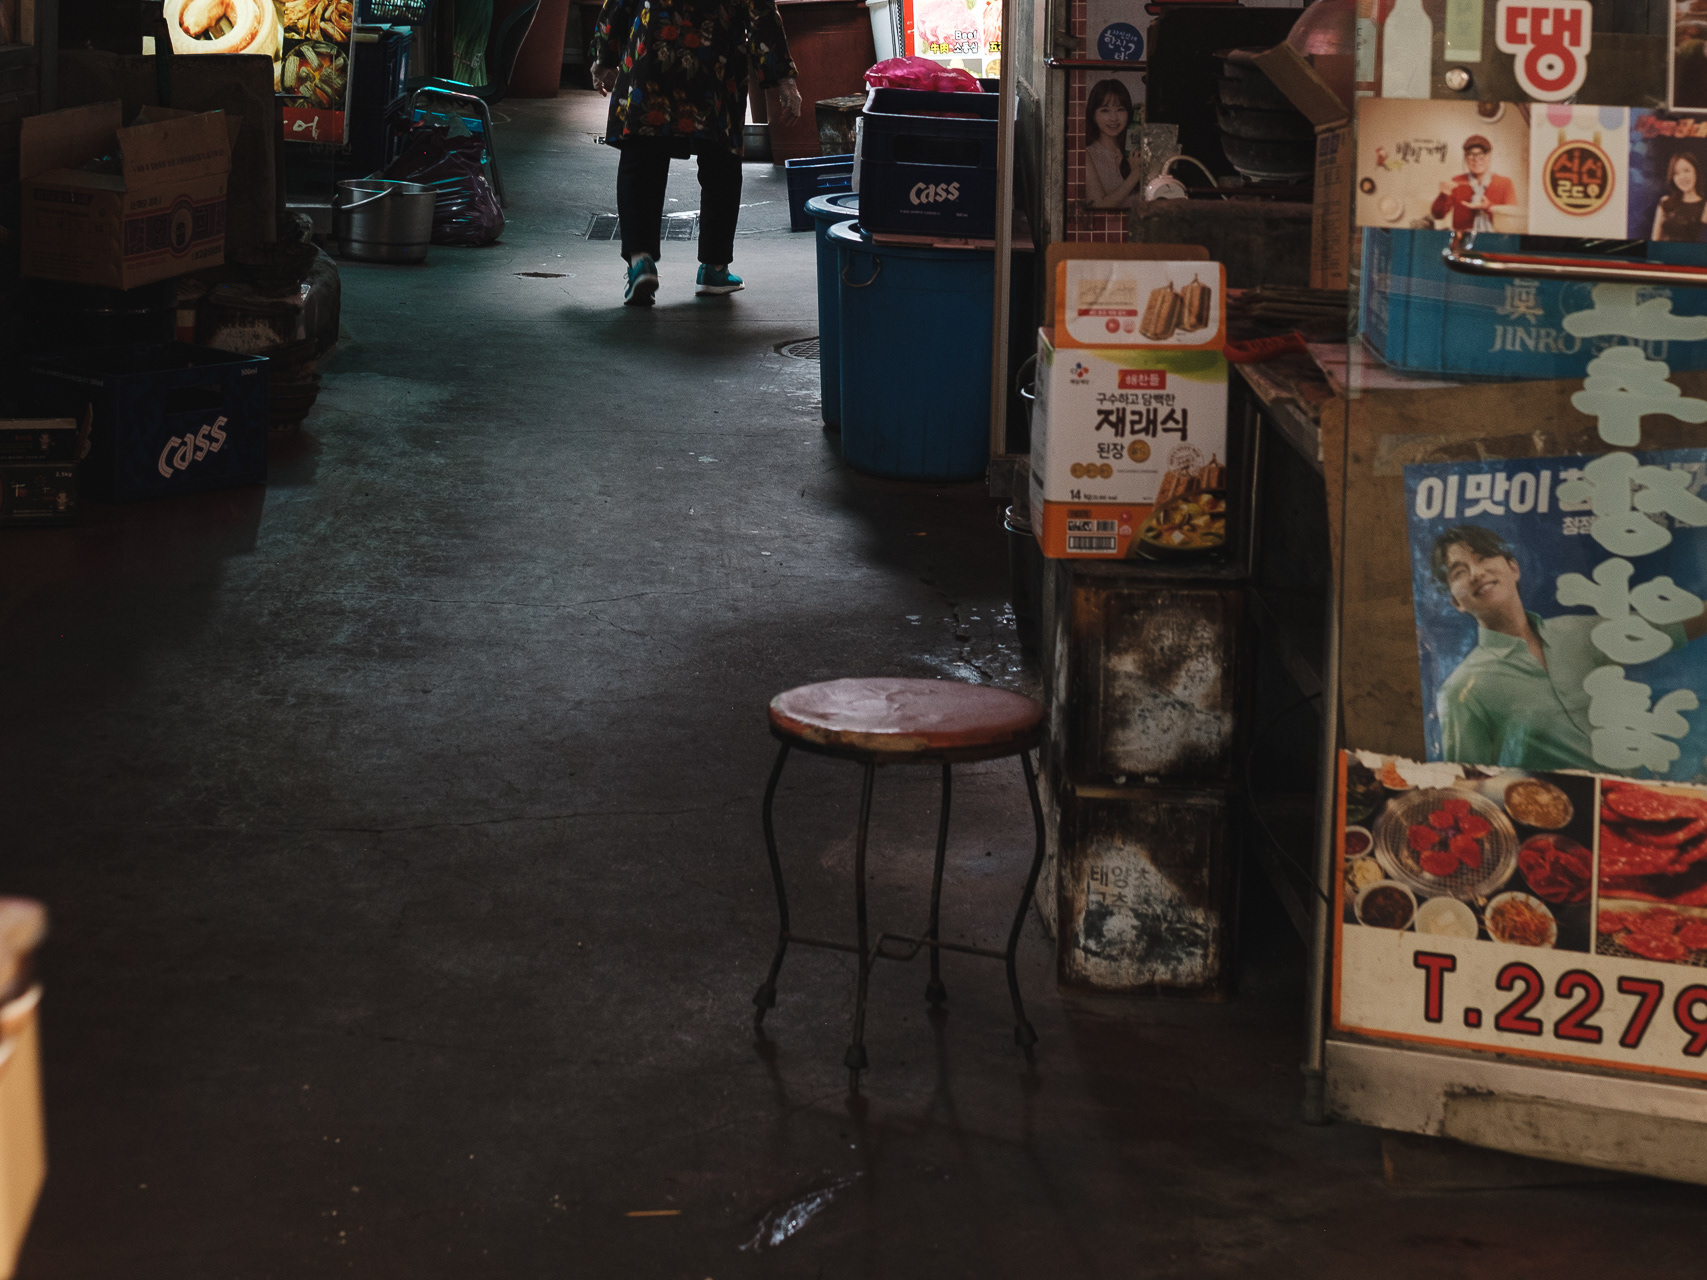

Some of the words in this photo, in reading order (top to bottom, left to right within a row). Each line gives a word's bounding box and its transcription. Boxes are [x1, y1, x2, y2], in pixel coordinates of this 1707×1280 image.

[954, 30, 978, 41] Beef
[1488, 324, 1583, 355] JINRO
[1096, 393, 1139, 406] 구수하고
[1095, 407, 1188, 441] 재래식
[1096, 442, 1125, 460] 된장
[1070, 489, 1082, 500] 14
[1415, 474, 1459, 520] 이
[1464, 470, 1552, 518] 맛이
